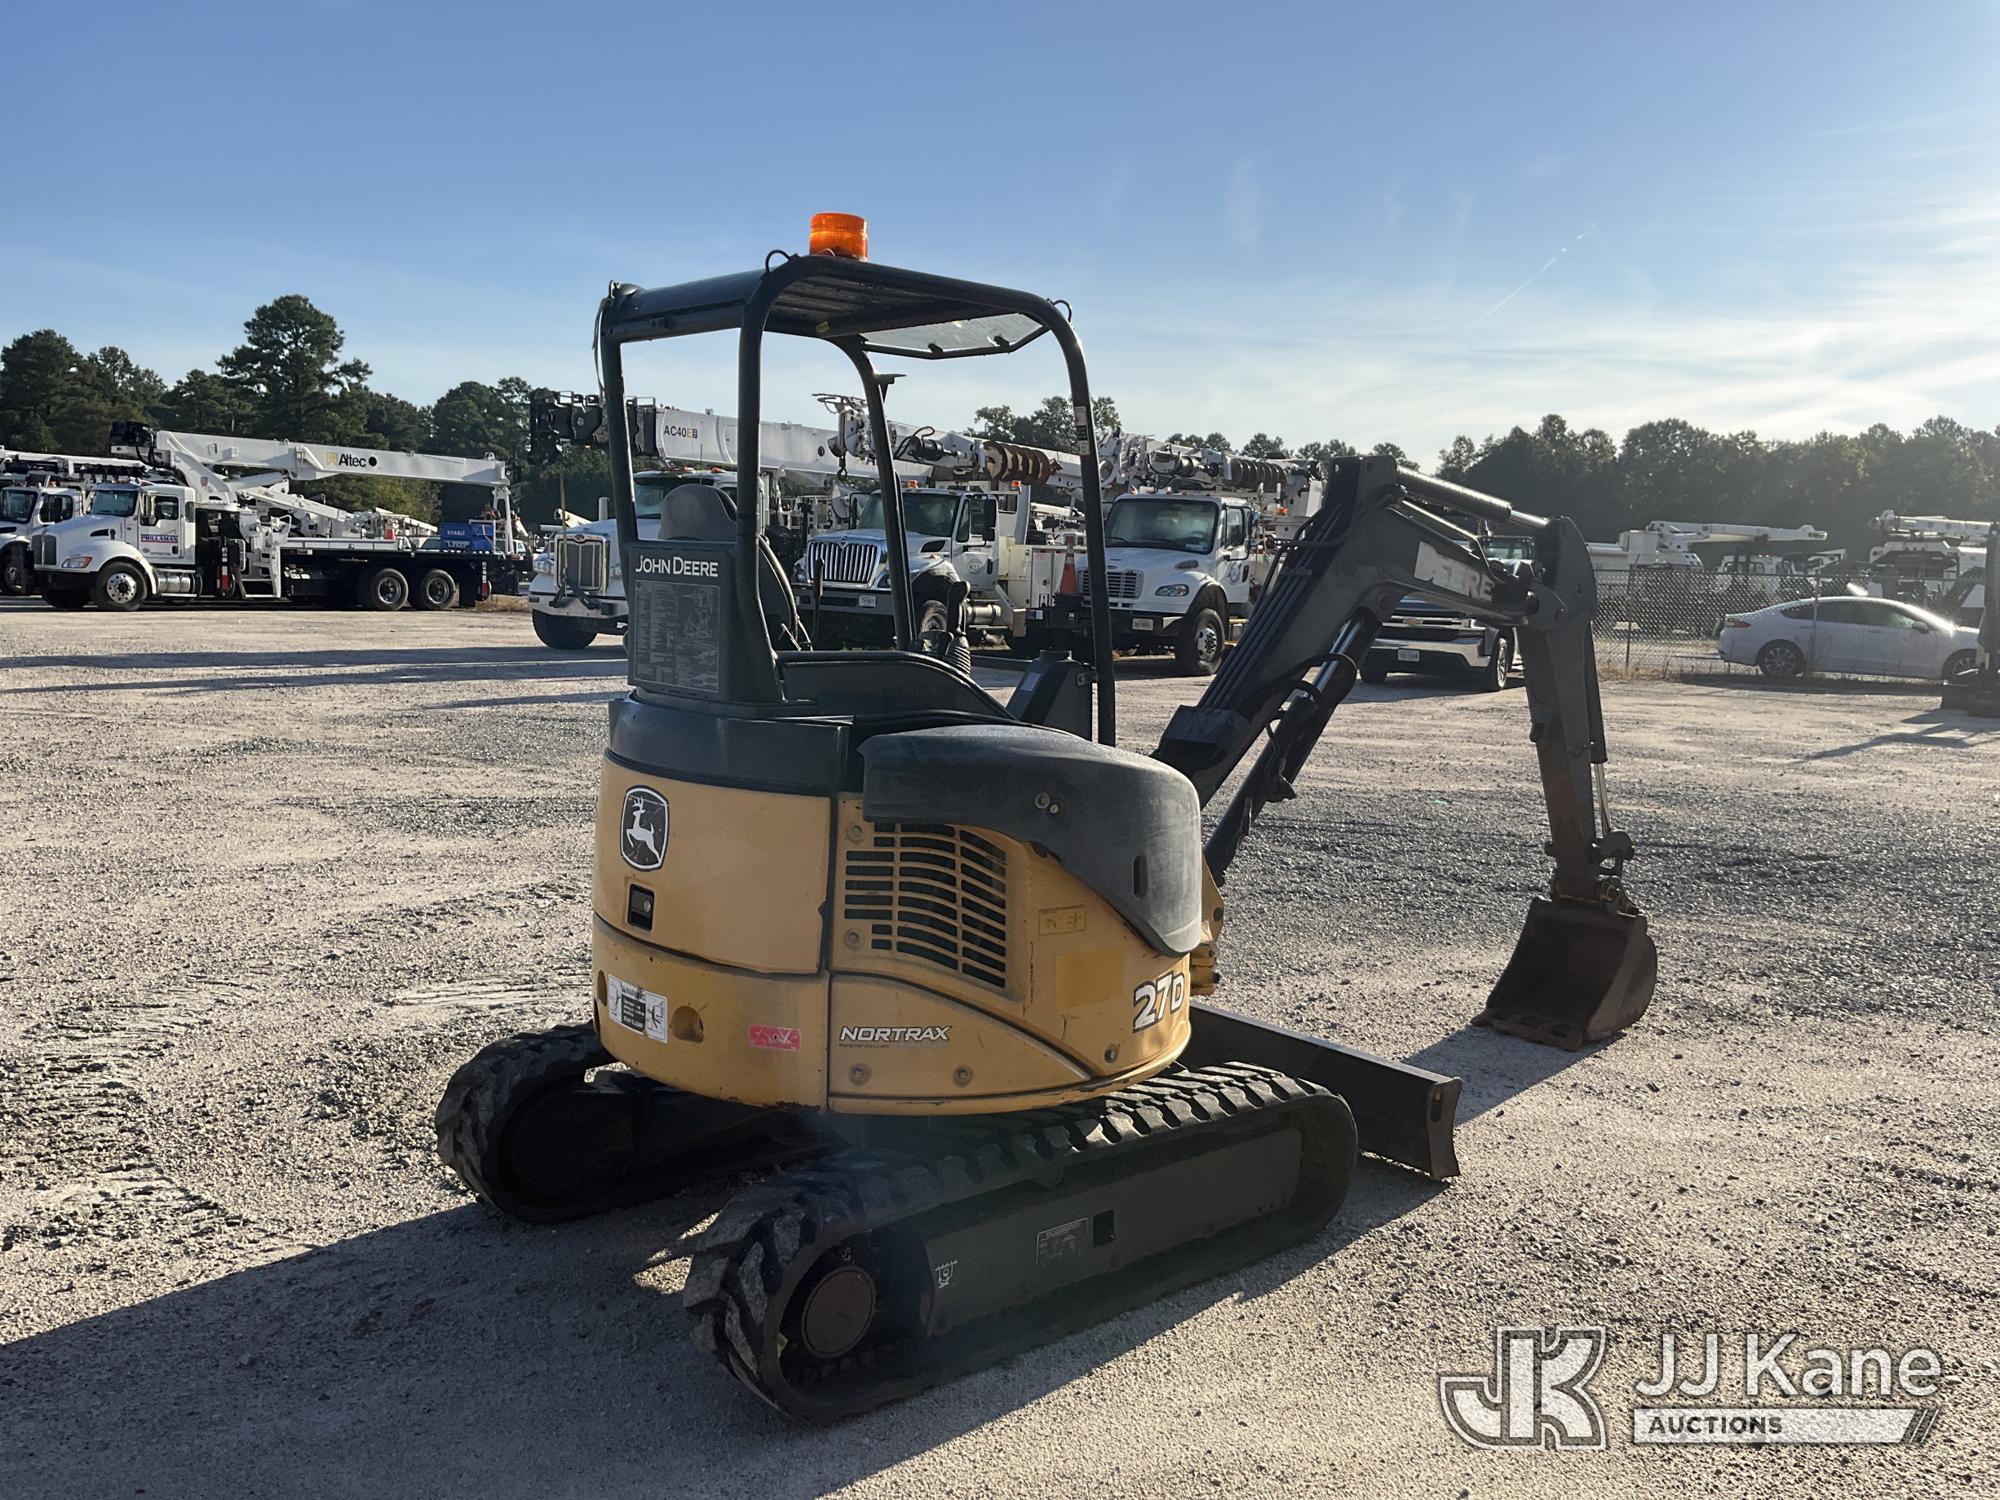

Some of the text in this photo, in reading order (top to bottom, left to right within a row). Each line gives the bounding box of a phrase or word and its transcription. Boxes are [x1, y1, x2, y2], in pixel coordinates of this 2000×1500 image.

[339, 453, 367, 468] Altec
[635, 555, 719, 578] JOHN DEERE
[1132, 970, 1185, 1034] 27D
[840, 1025, 953, 1042] NORTRAX
